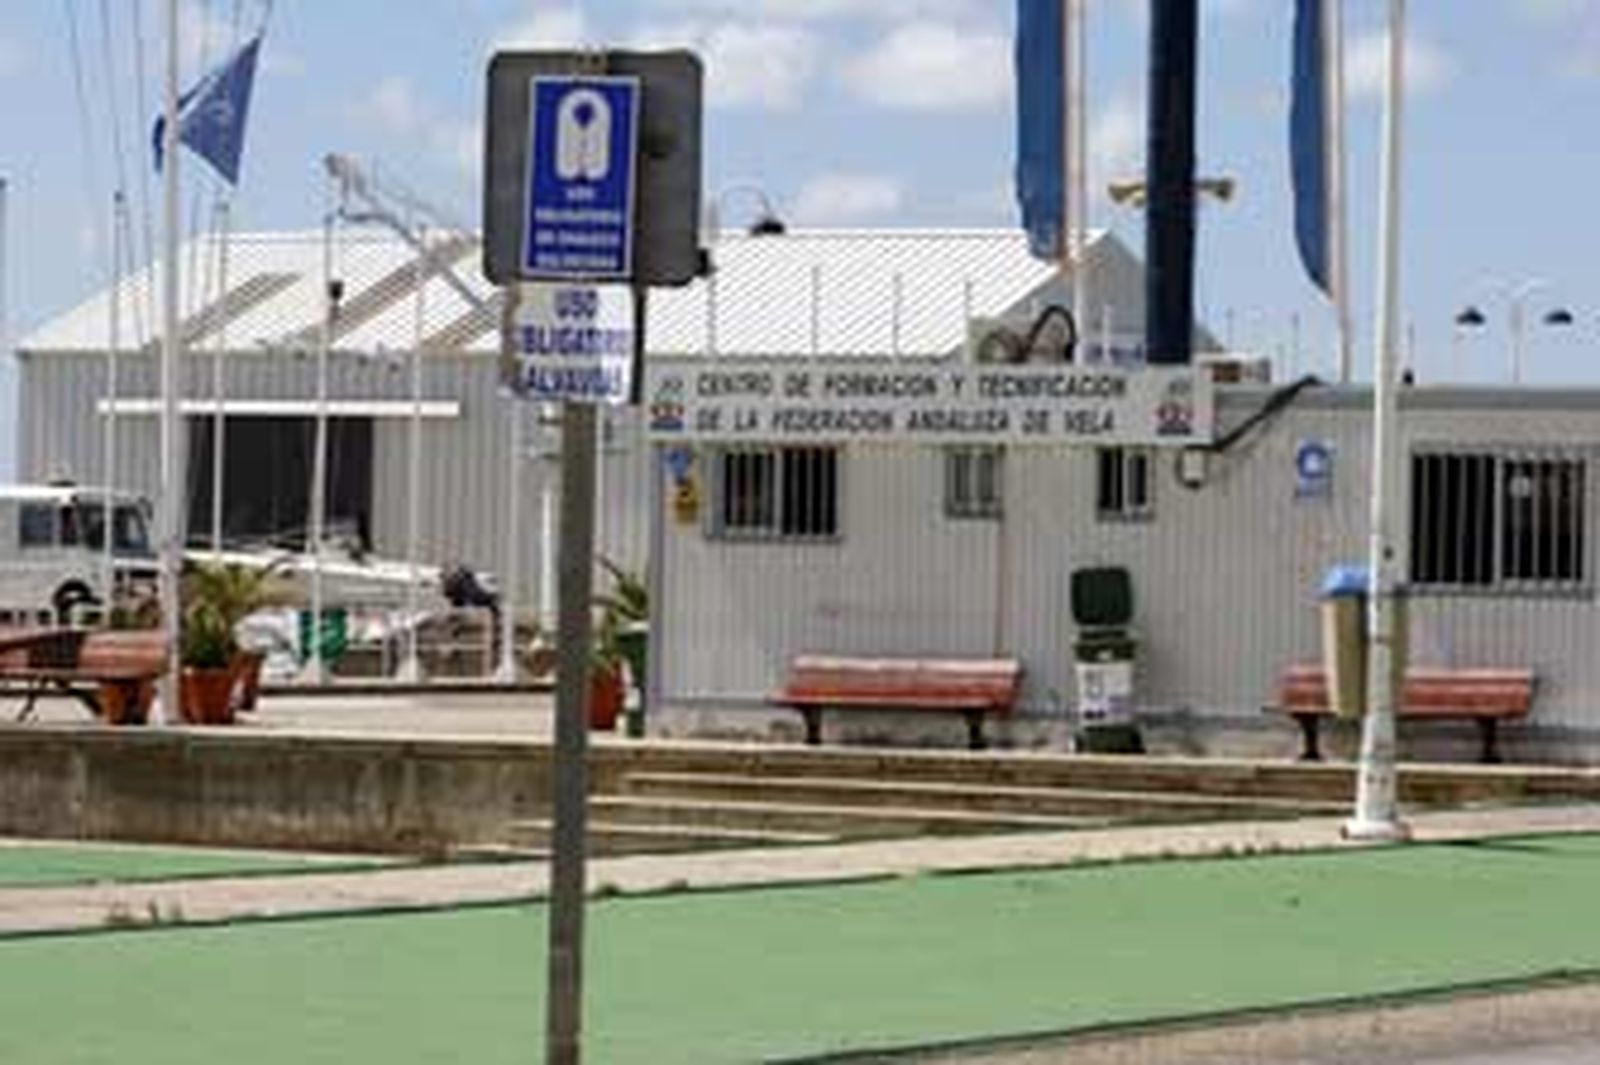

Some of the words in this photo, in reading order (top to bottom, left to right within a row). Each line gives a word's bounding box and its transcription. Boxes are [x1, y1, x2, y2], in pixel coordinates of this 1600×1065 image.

[555, 288, 598, 319] USO
[697, 372, 772, 398] CENTRO
[783, 373, 810, 398] DE
[951, 373, 964, 397] Y
[977, 373, 1127, 398] TECNIFICACION
[696, 407, 721, 432] DE
[734, 408, 758, 432] LA
[771, 408, 894, 433] FEDERACION
[906, 408, 1010, 433] ANDALUZA
[1021, 409, 1050, 434] DE
[1063, 408, 1115, 434] VELA
